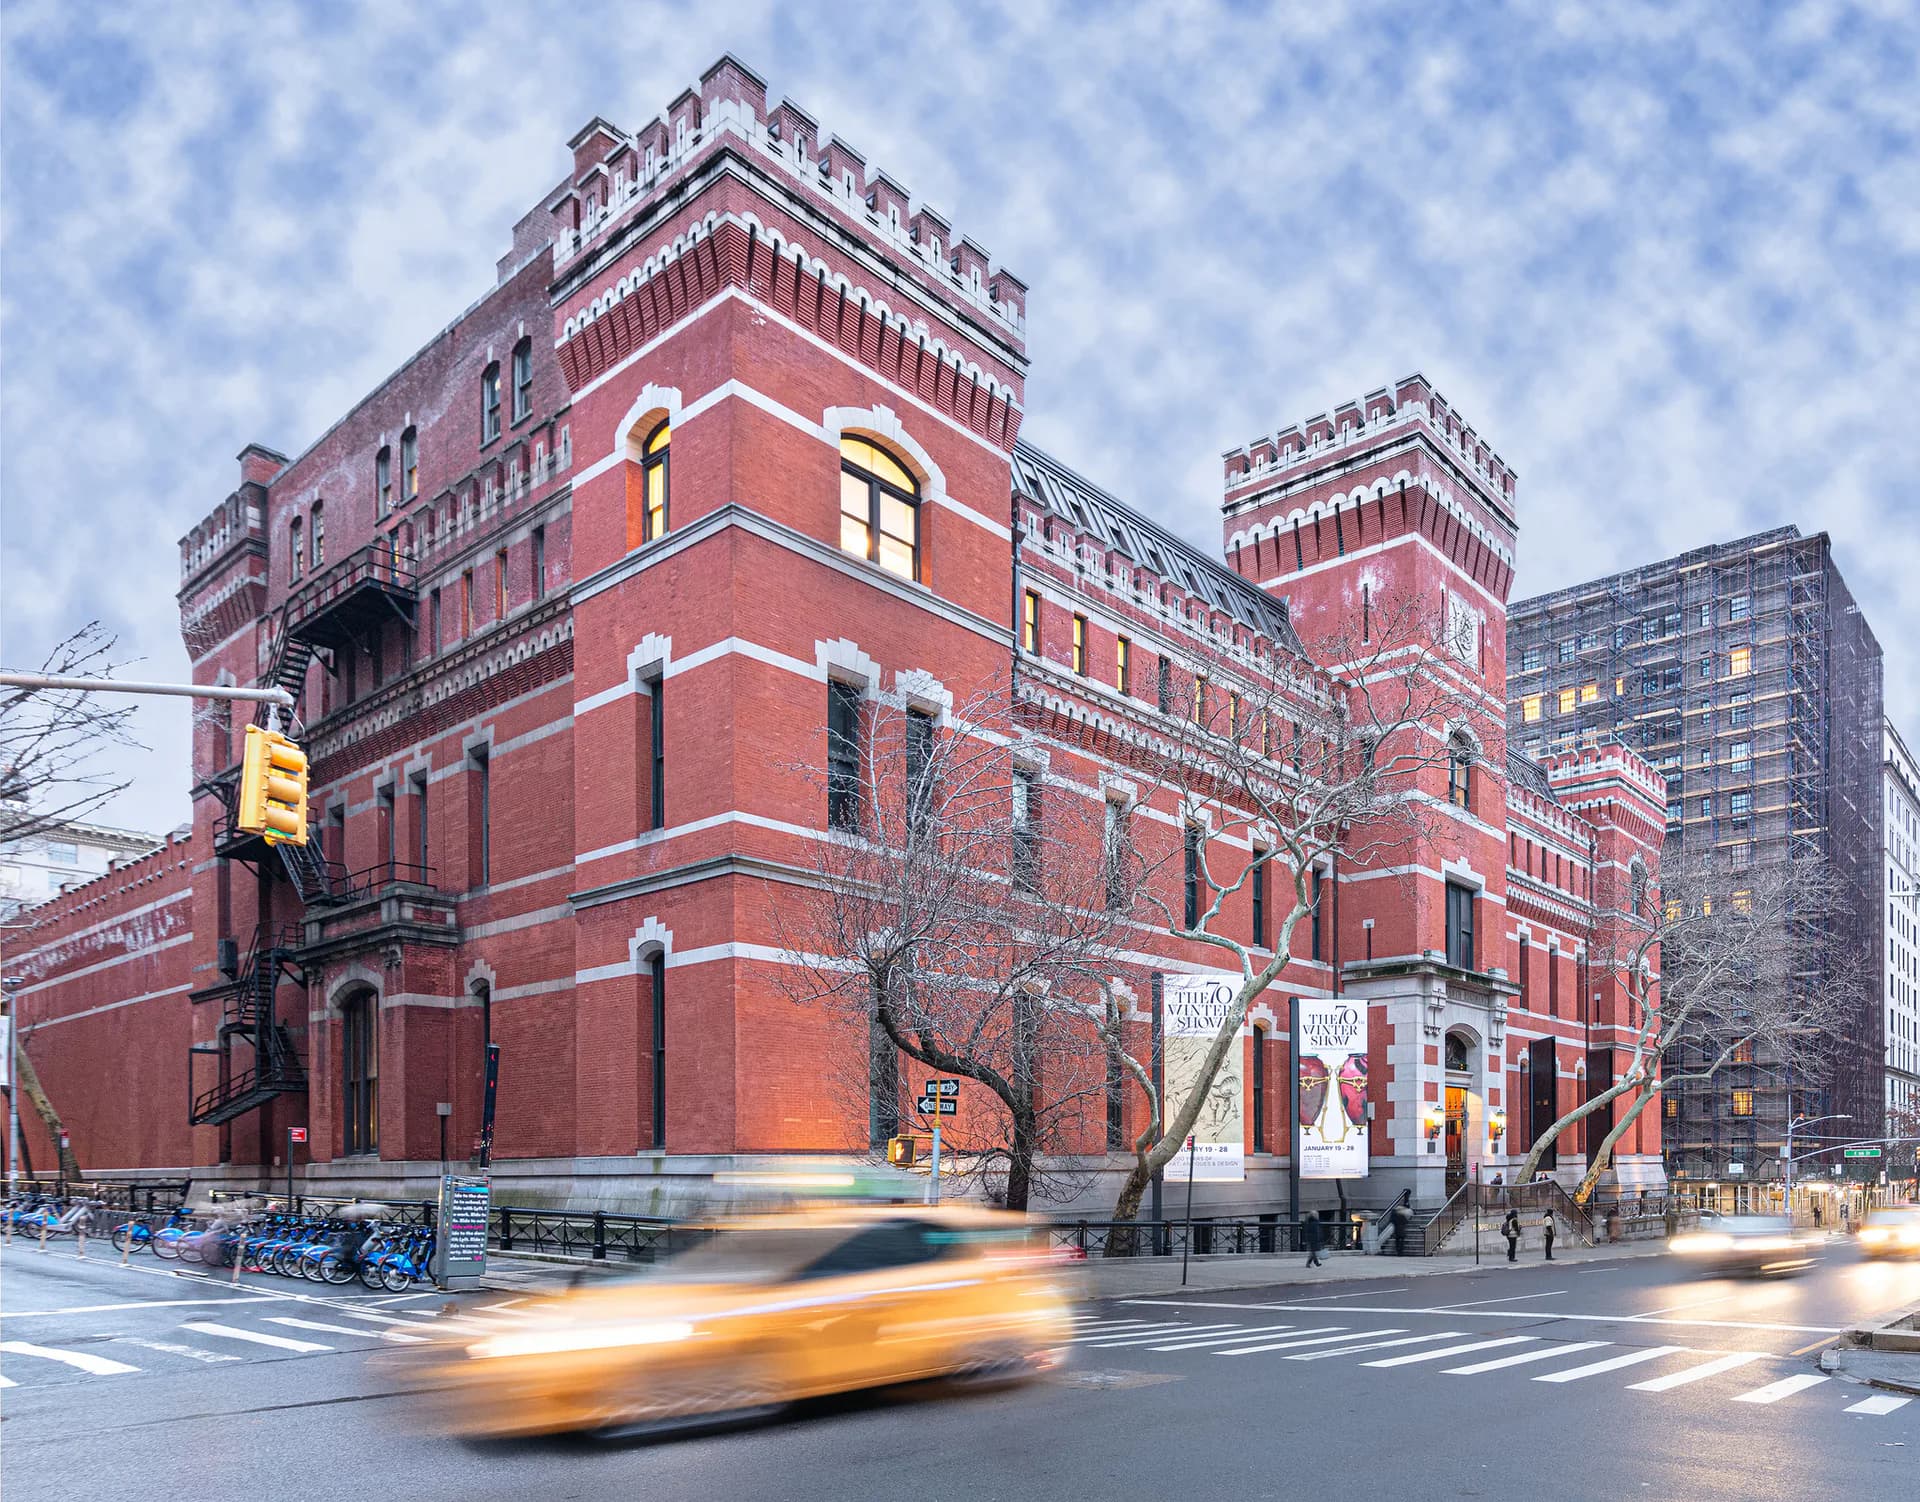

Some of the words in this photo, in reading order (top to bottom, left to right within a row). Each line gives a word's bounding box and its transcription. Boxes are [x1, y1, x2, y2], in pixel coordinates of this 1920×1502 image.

[1174, 992, 1208, 1004] THE
[1206, 981, 1233, 1004] 70
[1308, 1014, 1337, 1025] THE
[1335, 1005, 1358, 1025] 70
[1177, 1016, 1222, 1029] SHOW
[1303, 1024, 1357, 1036] WINTER
[1311, 1035, 1349, 1046] SHOW
[940, 1103, 952, 1111] WAY
